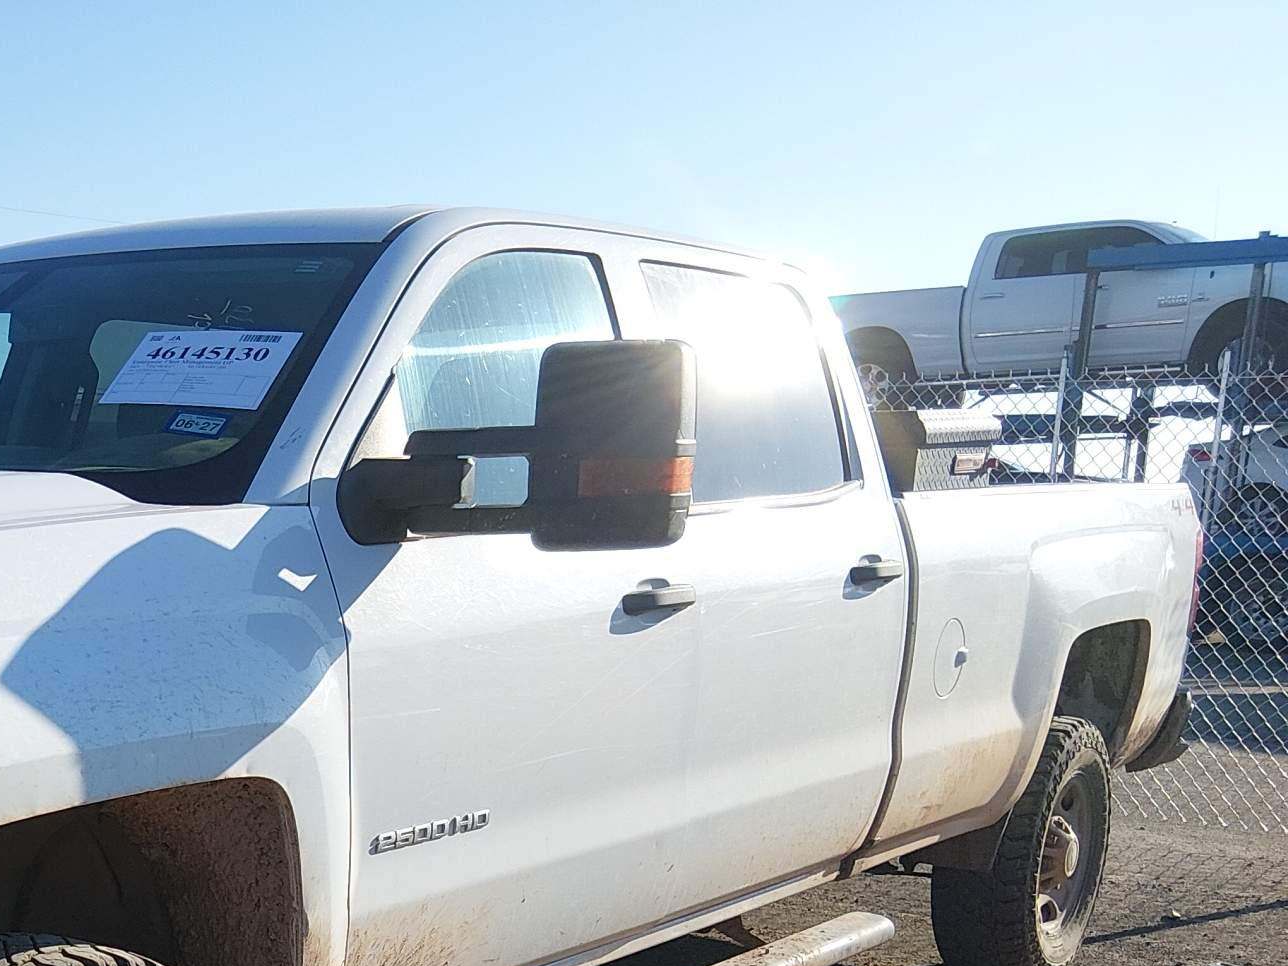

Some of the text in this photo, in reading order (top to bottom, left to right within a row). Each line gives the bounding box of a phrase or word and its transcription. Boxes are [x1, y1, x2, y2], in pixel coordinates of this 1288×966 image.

[146, 346, 270, 361] 46145130
[176, 419, 195, 428] 06
[200, 421, 220, 431] 27
